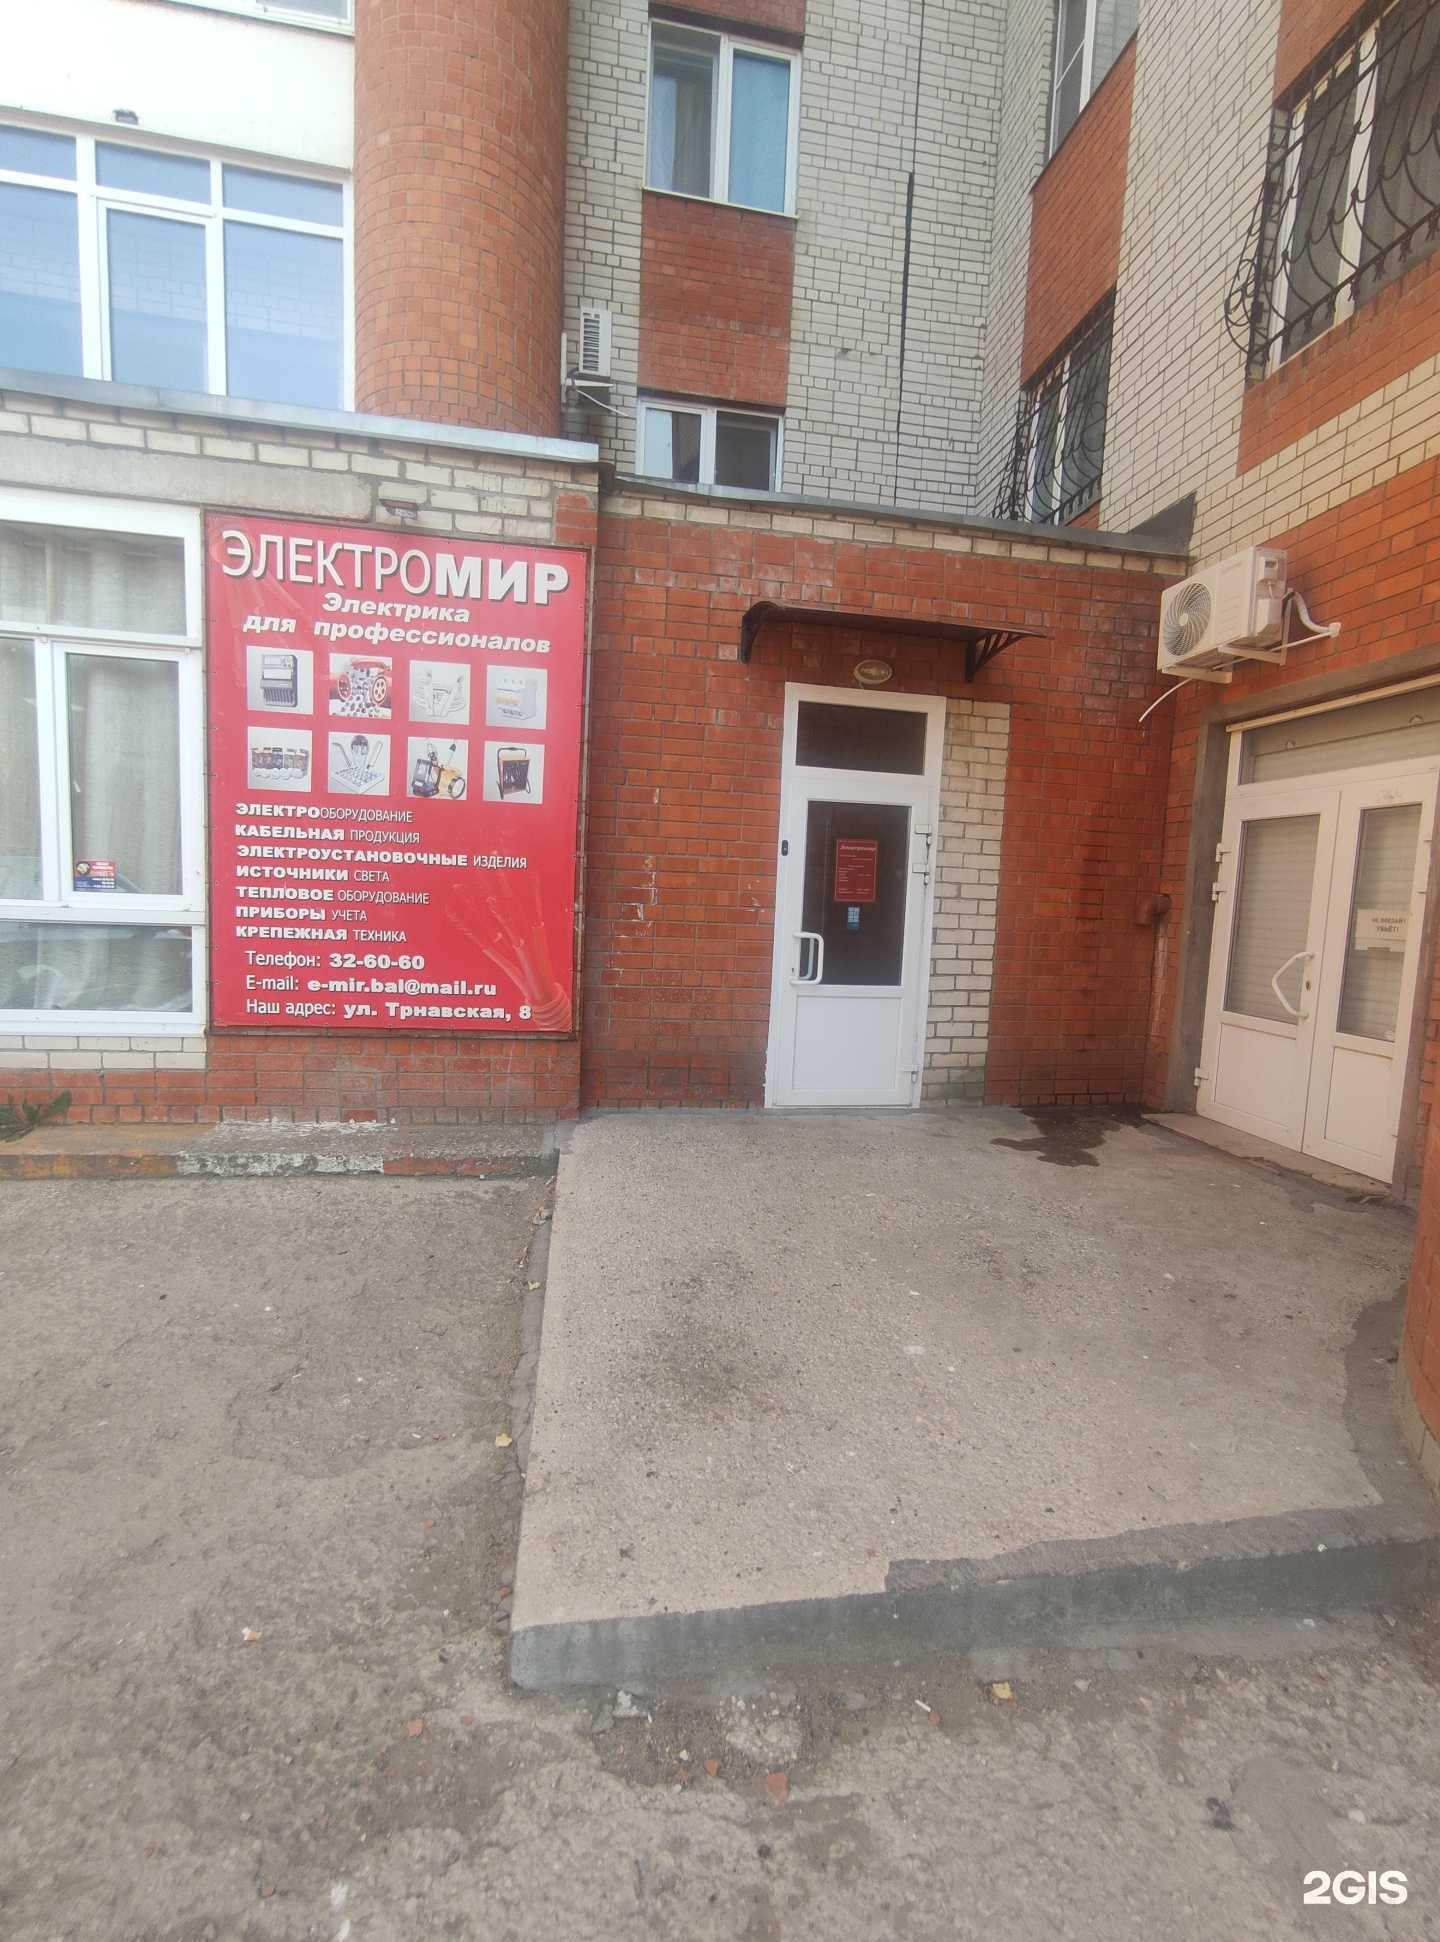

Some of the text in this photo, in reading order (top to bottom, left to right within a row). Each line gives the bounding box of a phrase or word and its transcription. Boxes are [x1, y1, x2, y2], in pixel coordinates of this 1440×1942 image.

[222, 529, 569, 605] ЭЛЕКТРОМИР
[323, 592, 471, 624] Электрика
[242, 614, 551, 654] для профессионалов
[235, 802, 413, 824] ЭЛЕКТРООБОРУДОВАНИЕ
[235, 824, 420, 844] КАБЕЛЬНАЯ ПРОДУКЦИЯ
[236, 845, 527, 870] ЭЛЕКТРОУСТАНОВОЧНЫЕ ИЗДЕЛИЯ
[236, 865, 390, 882] ИСТОЧНИКИ СВЕТА
[236, 886, 430, 905] ТЕПЛОВОЕ ОБОРУДОВАНИЕ
[236, 906, 368, 922] ПРИБОРЫ УЧЕТА
[236, 926, 407, 942] КРЕПЕЖНАЯ ТЕХНИКА
[246, 951, 425, 970] Телефон: 32-60-60
[246, 975, 496, 996] E-mail: e-mir.bal@mail.ru
[246, 999, 531, 1022] Наш адрес: ул. Трнавская, 8
